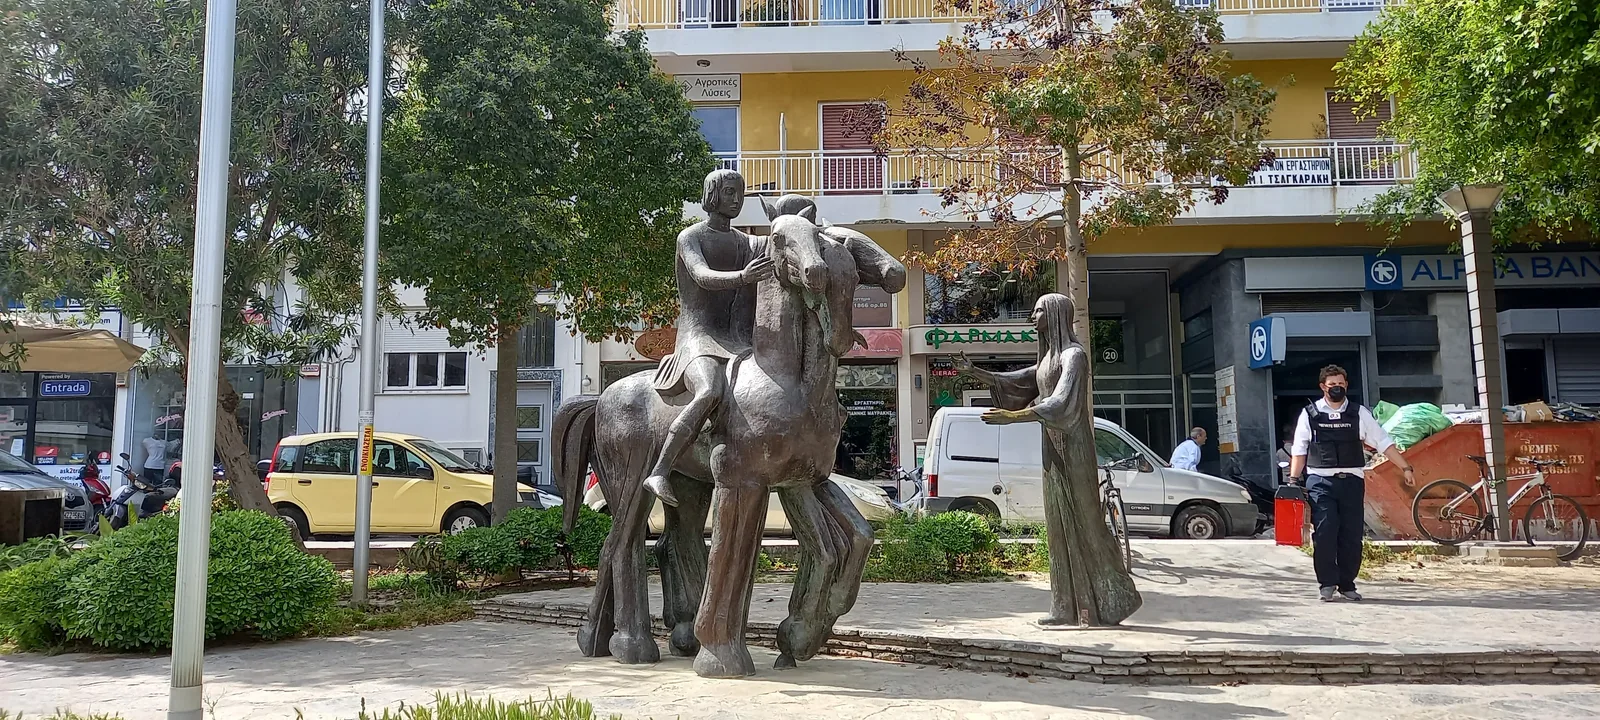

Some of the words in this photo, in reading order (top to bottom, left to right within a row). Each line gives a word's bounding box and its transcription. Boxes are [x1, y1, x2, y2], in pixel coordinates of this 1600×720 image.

[694, 78, 738, 88] Αγροτικές
[701, 89, 732, 99] Λύσεις
[1286, 159, 1330, 171] ΕΡΓΑΣΤΗΡΙΟΝ
[1267, 174, 1329, 184] ΤΣΑΓΚΑΡΑΚΗ
[1411, 258, 1524, 280] ALPA
[1105, 351, 1116, 360] 20
[45, 383, 85, 392] Entrada
[361, 427, 371, 472] ΕΝΟΙΚΙΑΖΕΤΑΙ
